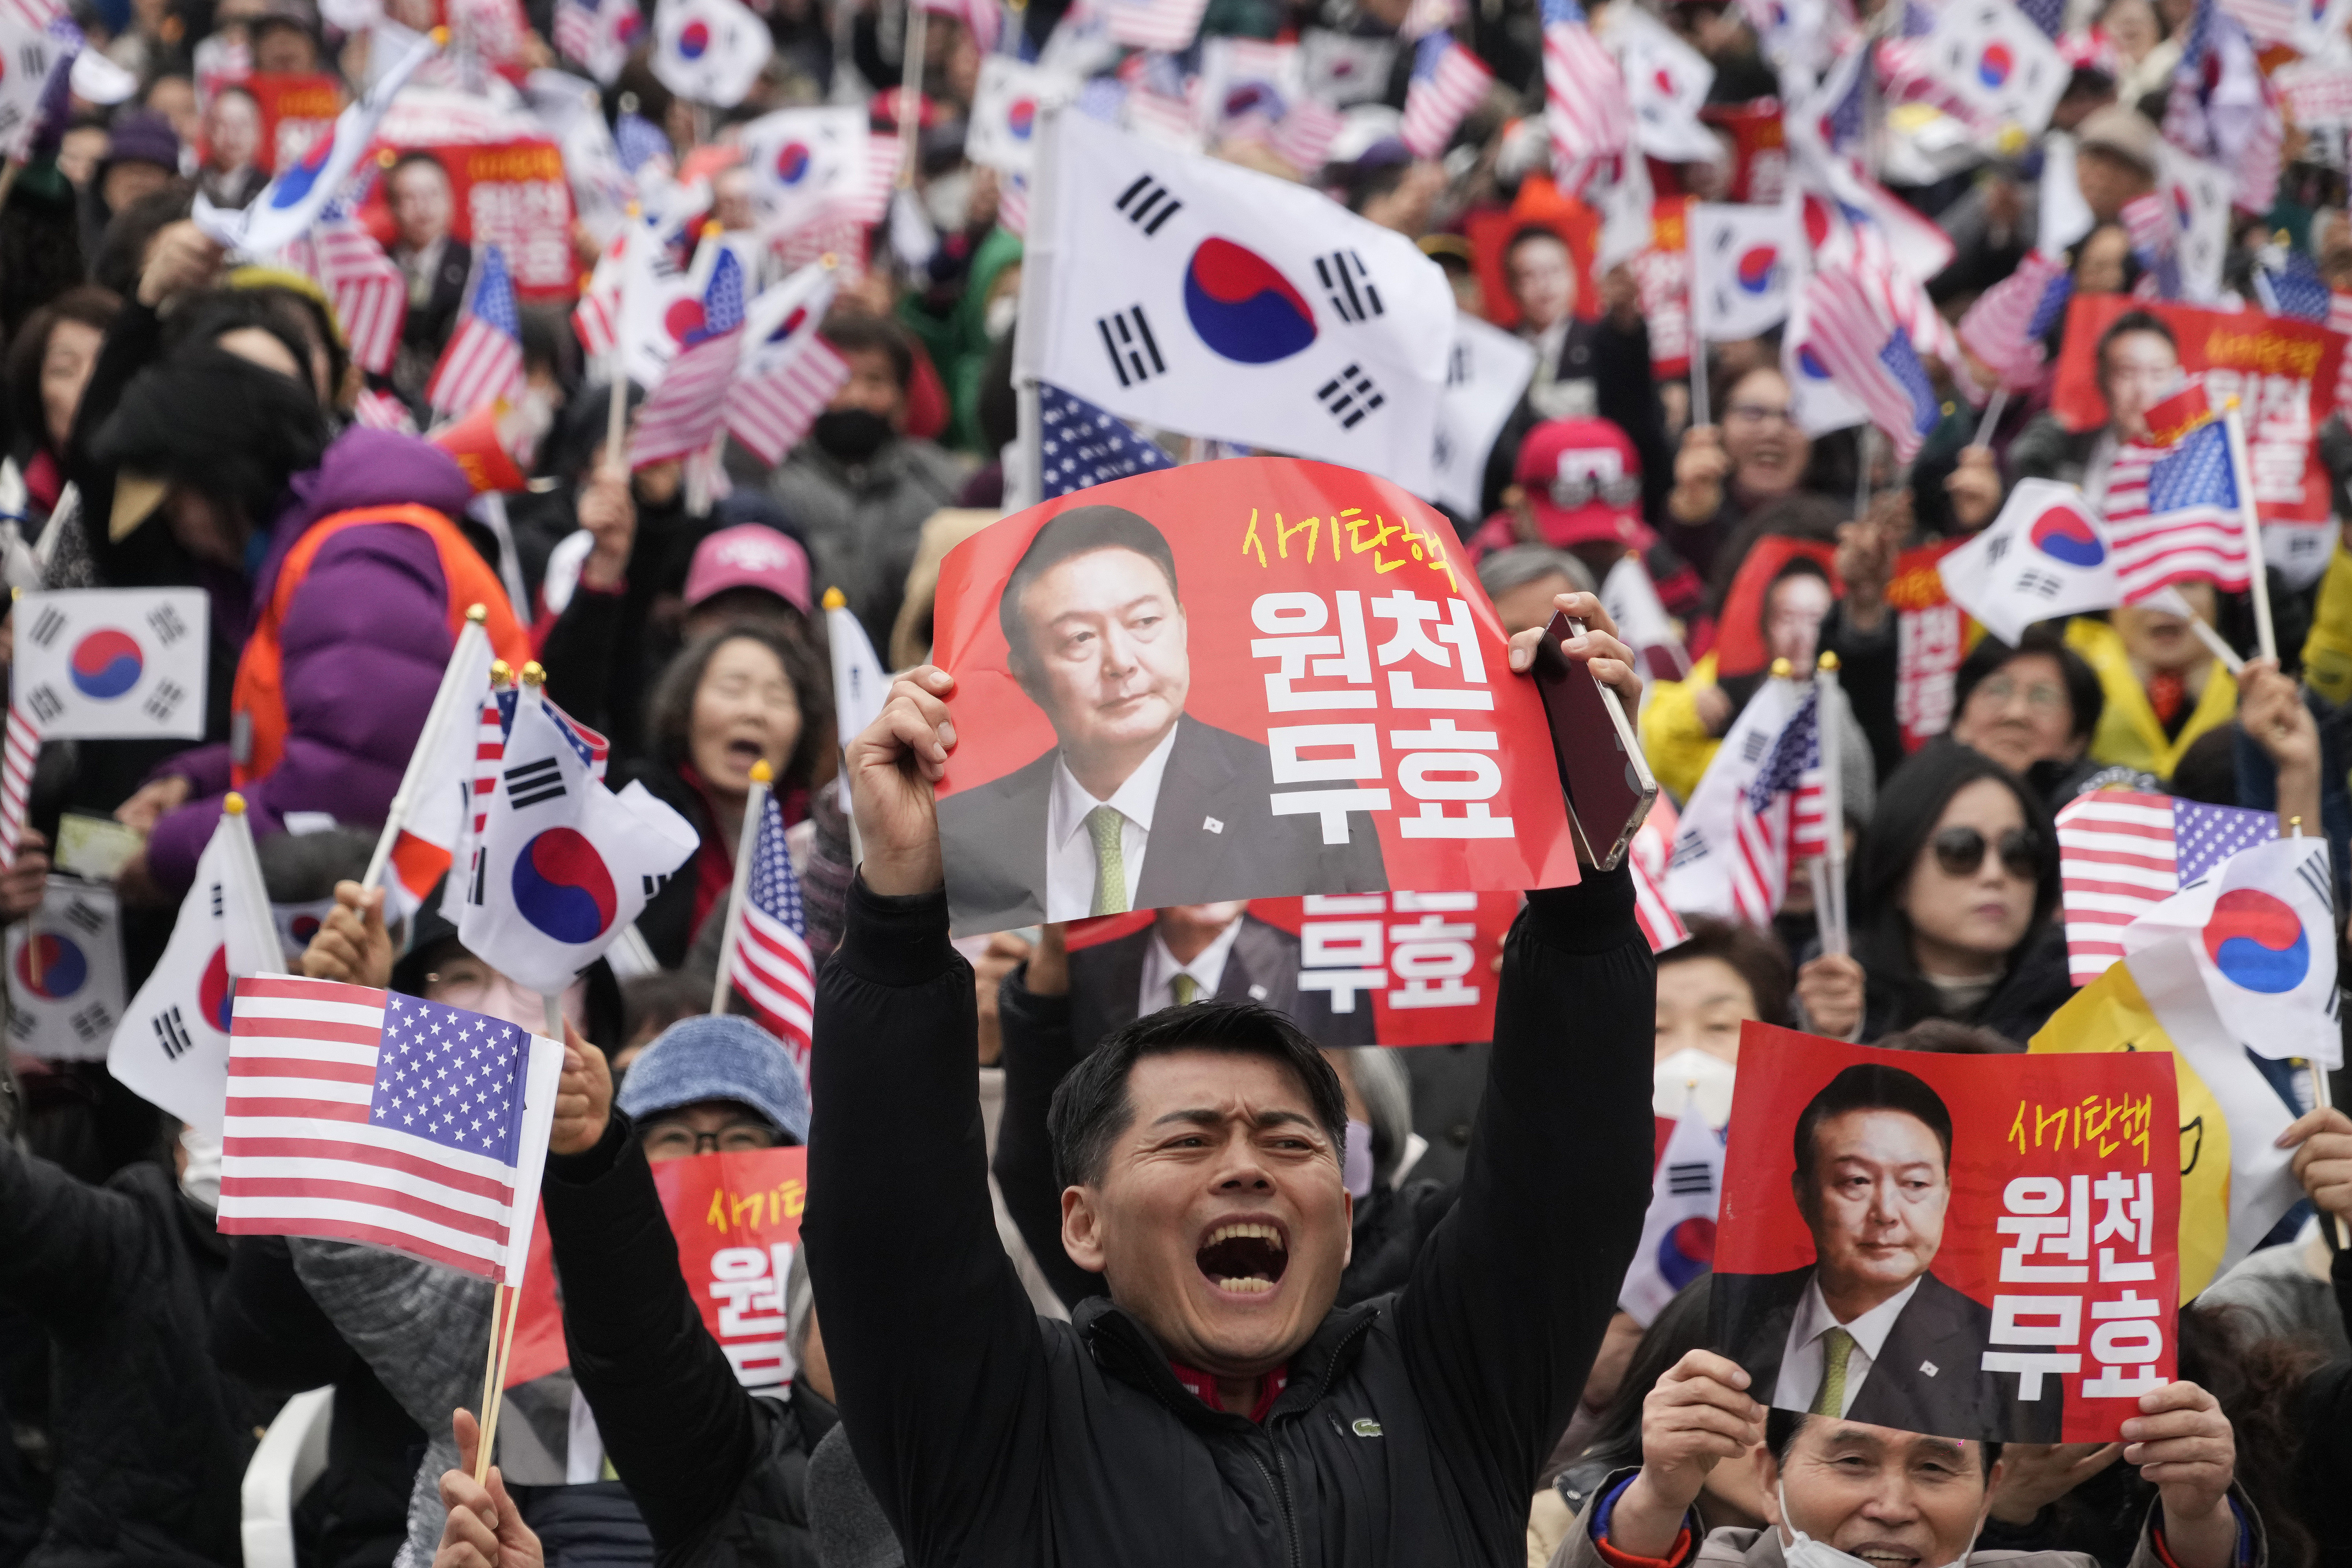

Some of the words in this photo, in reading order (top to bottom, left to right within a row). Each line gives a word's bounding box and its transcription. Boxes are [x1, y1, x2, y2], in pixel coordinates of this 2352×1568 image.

[1242, 507, 1458, 593] 사기탄핵
[1250, 589, 1494, 713] 원천
[1267, 718, 1515, 845] 무효
[1297, 915, 1479, 1014] 무효
[2009, 1093, 2152, 1166] 사기탄핵
[1996, 1171, 2156, 1283] 원천
[1981, 1289, 2169, 1402] 무효
